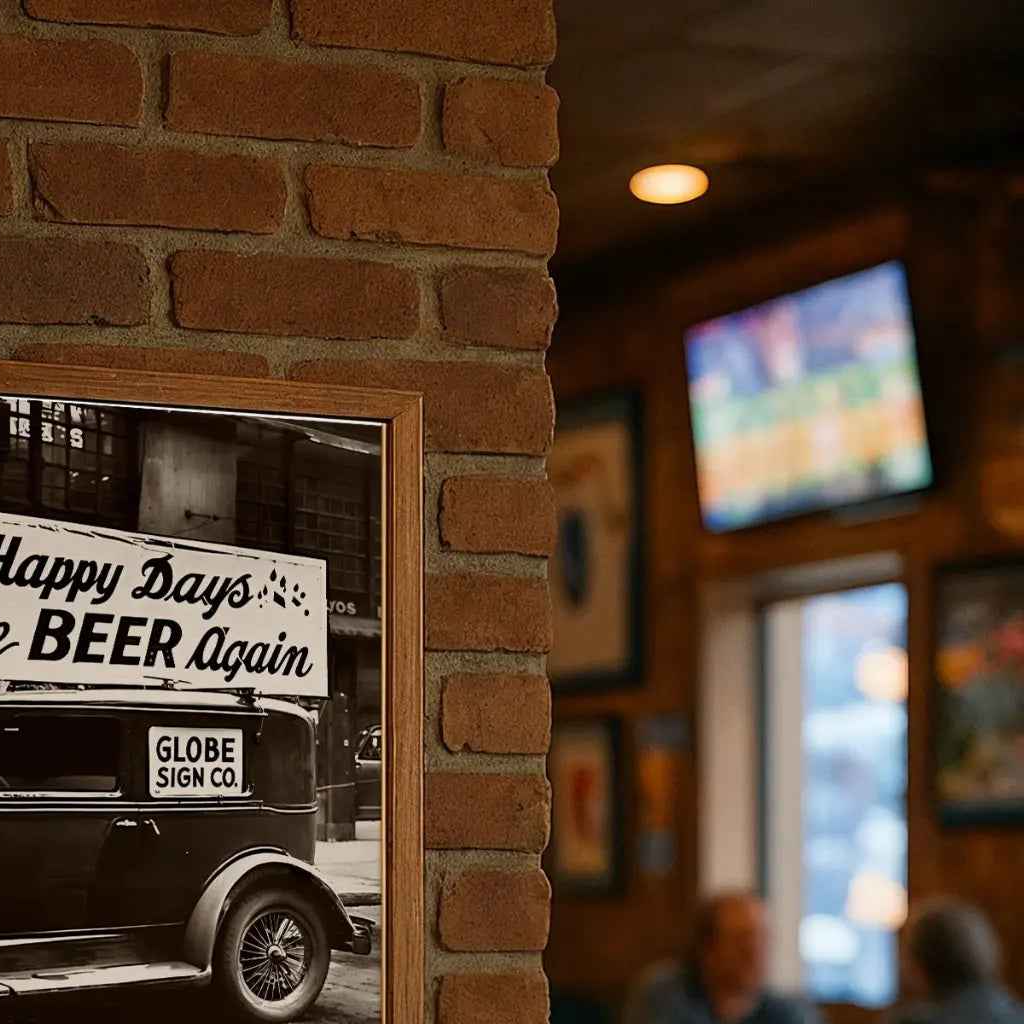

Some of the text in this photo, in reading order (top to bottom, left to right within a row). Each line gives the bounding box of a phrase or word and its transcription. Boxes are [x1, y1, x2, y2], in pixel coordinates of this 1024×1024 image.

[130, 551, 255, 621] Days
[27, 607, 183, 669] BEER
[184, 625, 314, 683] Again
[155, 735, 236, 764] GLOBE
[155, 766, 239, 789] SIGN CO.
